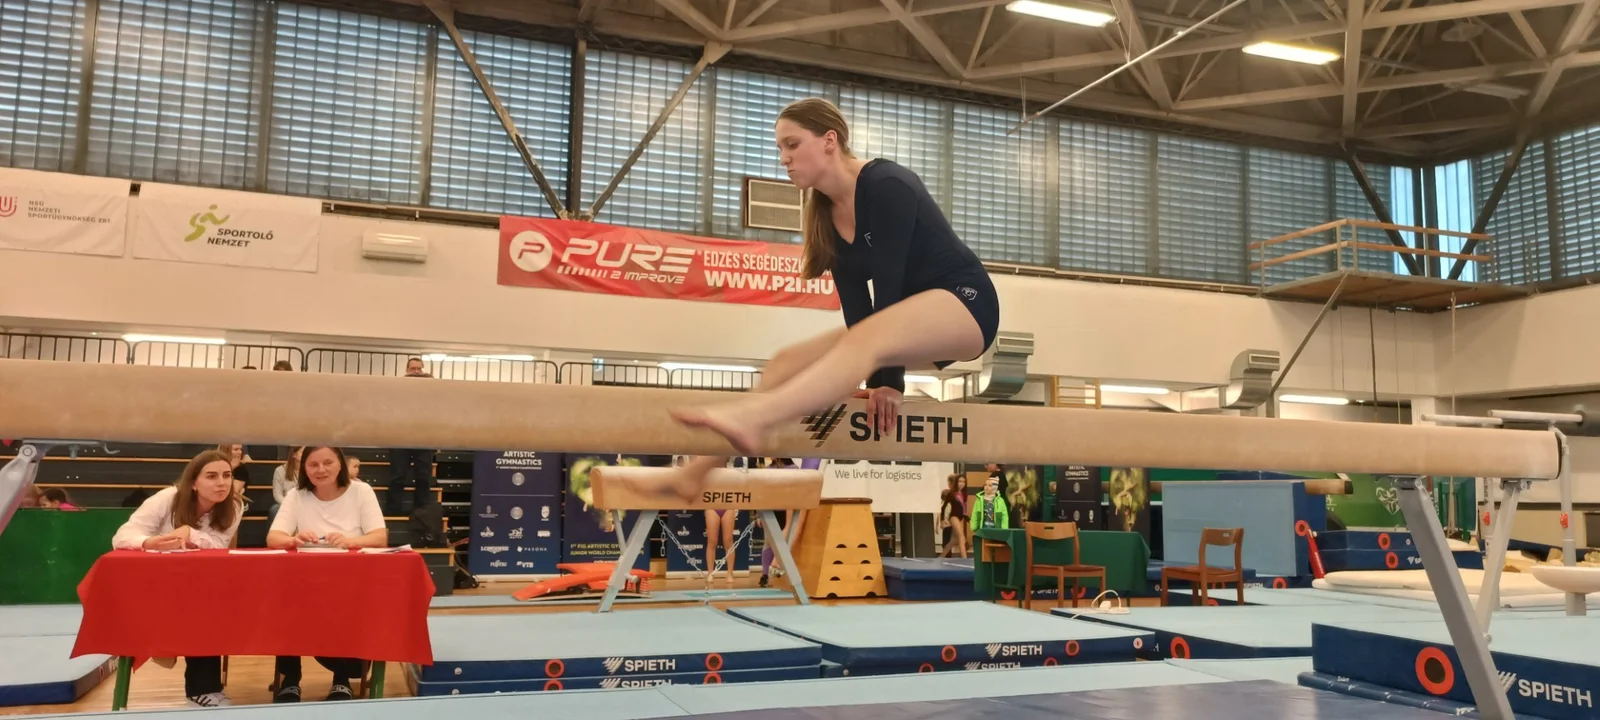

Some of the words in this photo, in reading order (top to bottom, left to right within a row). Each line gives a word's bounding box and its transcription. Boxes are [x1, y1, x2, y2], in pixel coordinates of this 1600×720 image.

[28, 206, 61, 214] NEMZETI
[217, 228, 274, 241] SPORTOLÓ
[207, 237, 251, 248] NEMZET
[561, 238, 696, 273] PURE
[703, 250, 741, 269] EDZÉS
[610, 270, 622, 279] 2
[624, 272, 686, 284] IMPROVE
[704, 270, 834, 295] WWW.P2I.HU
[495, 458, 542, 466] GYMNASTICS
[834, 470, 850, 479] We
[852, 468, 869, 479] live
[870, 469, 884, 479] for
[885, 469, 922, 482] logistics
[702, 491, 751, 503] SPIETH
[1002, 645, 1043, 656] SPIETH
[624, 659, 676, 672] SPIETH
[1518, 679, 1593, 708] SPIETH
